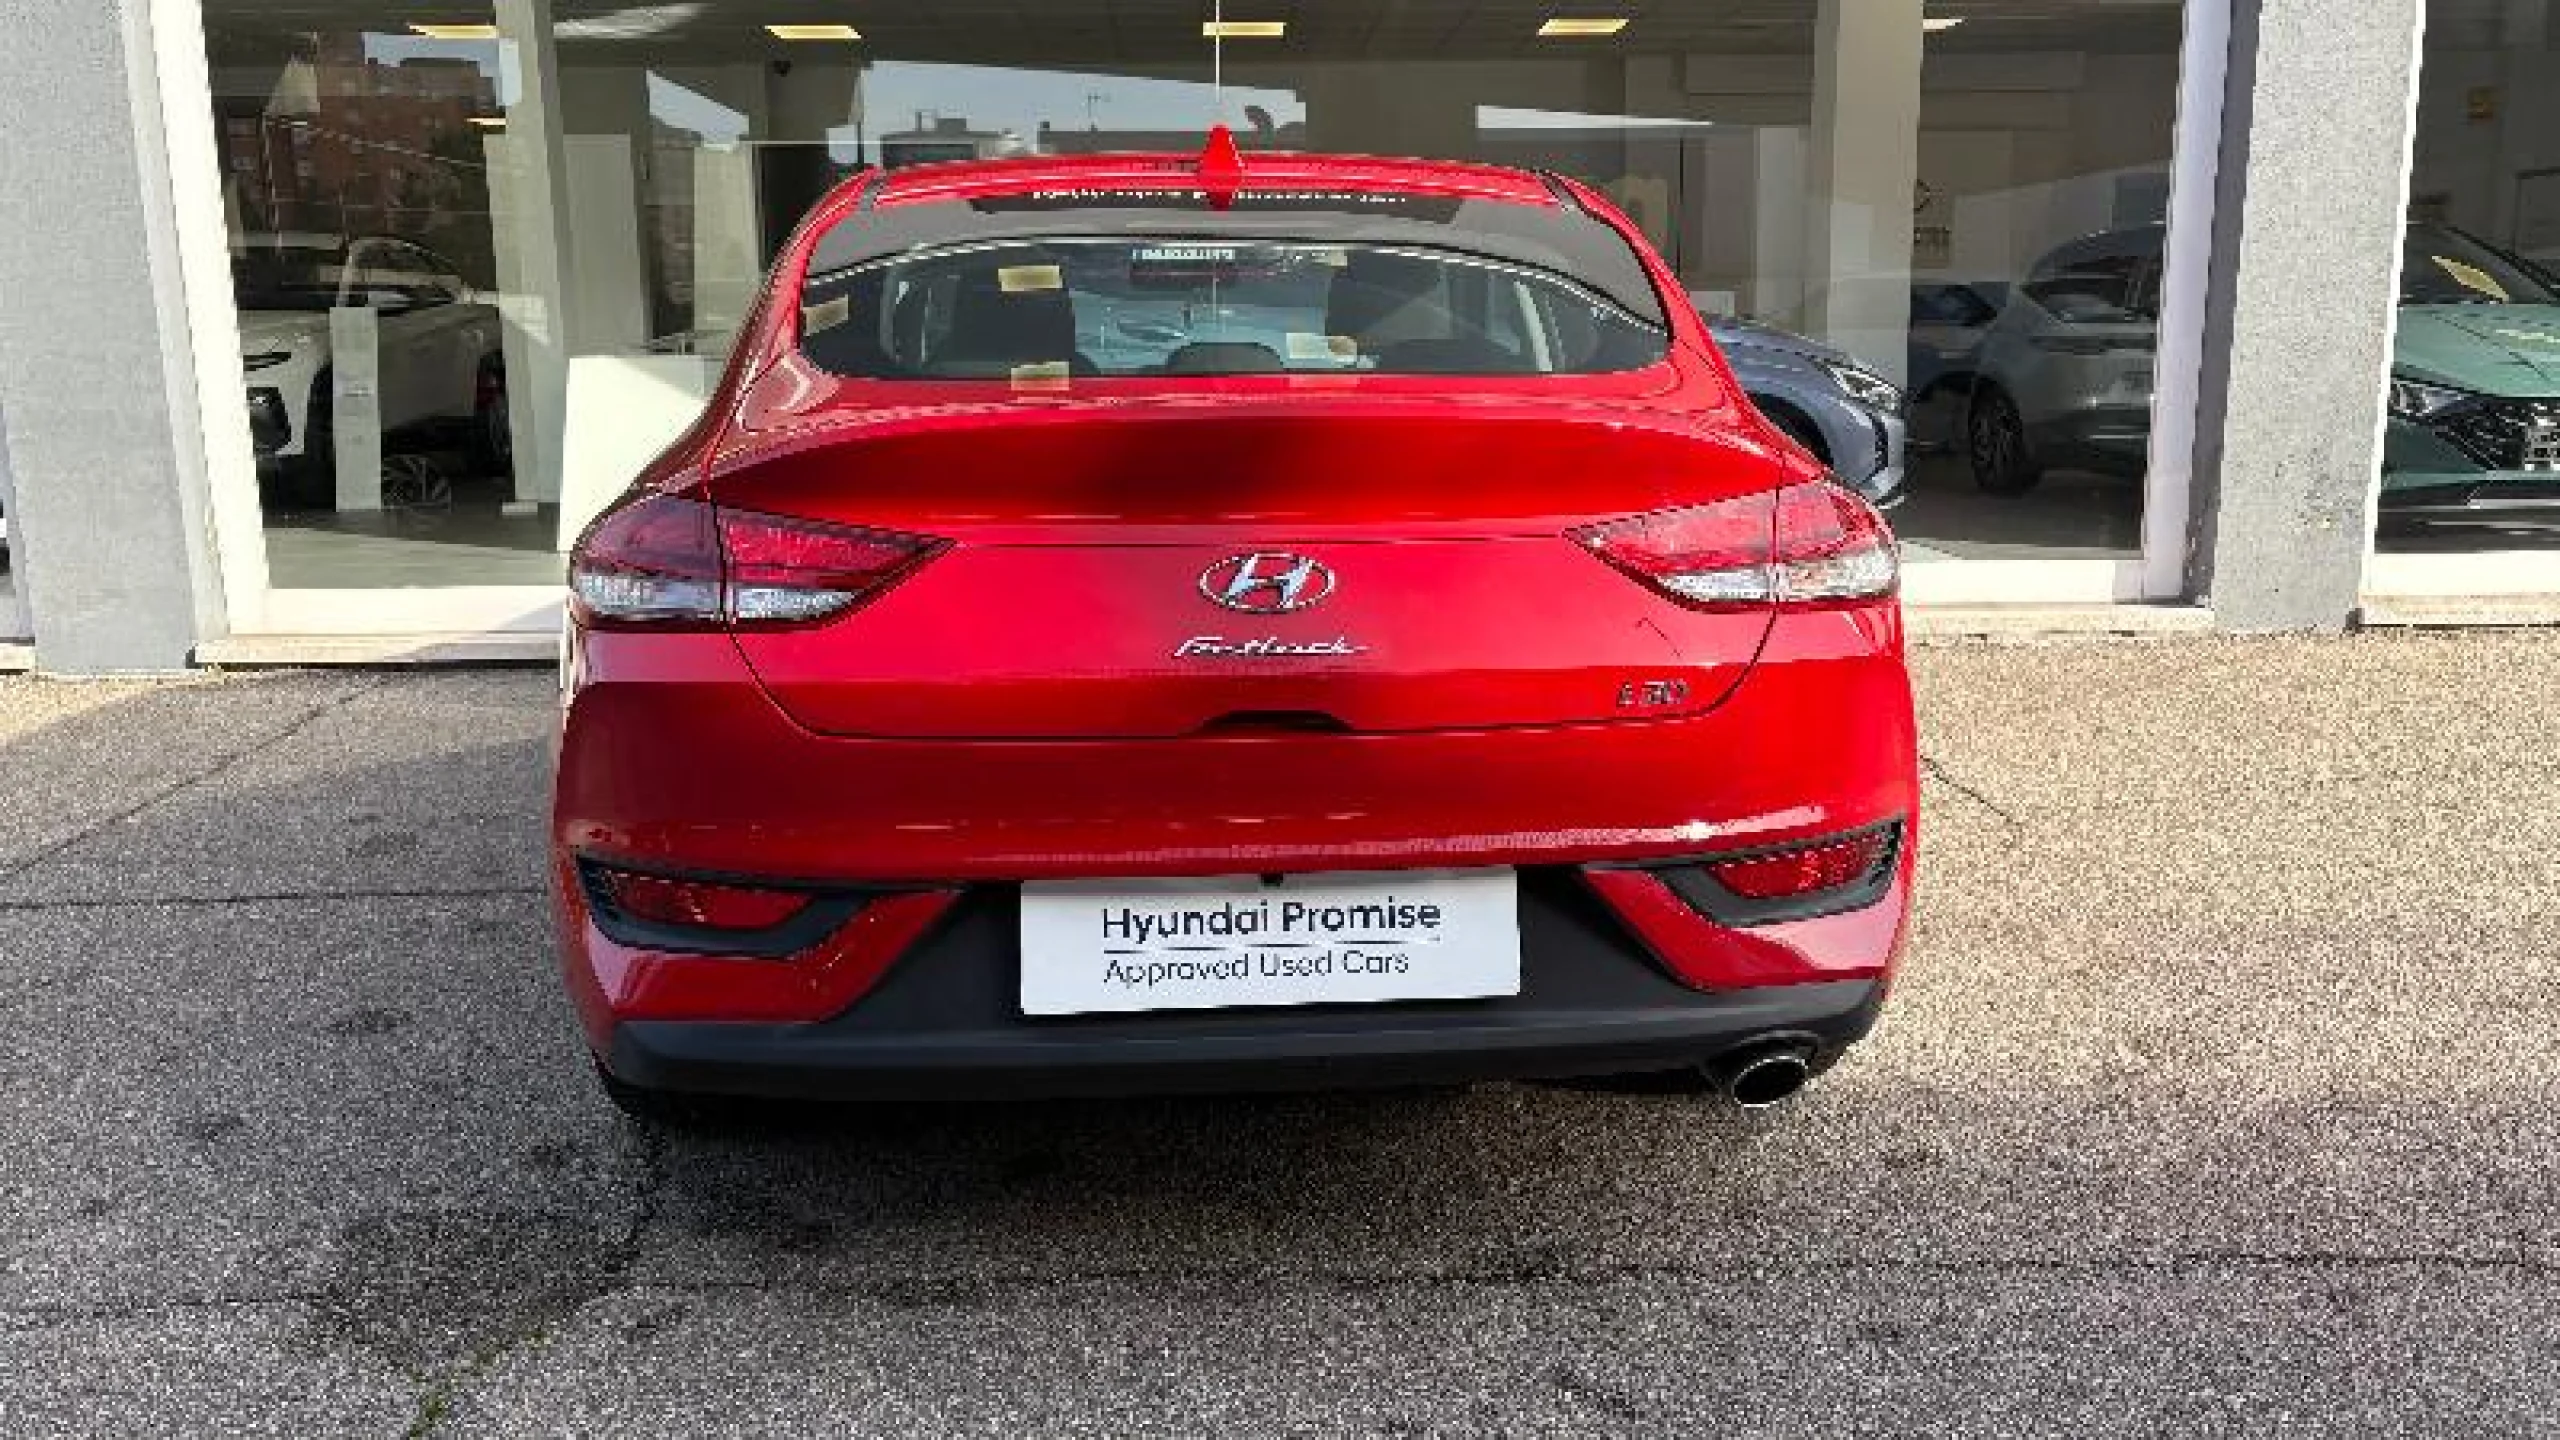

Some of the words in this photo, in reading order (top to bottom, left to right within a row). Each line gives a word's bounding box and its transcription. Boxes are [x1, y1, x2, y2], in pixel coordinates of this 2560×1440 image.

[1102, 900, 1269, 944] Hyundai
[1281, 896, 1442, 933] Promise
[1103, 953, 1249, 988] Approved
[1259, 949, 1332, 977] Used
[1342, 948, 1409, 974] Cars
